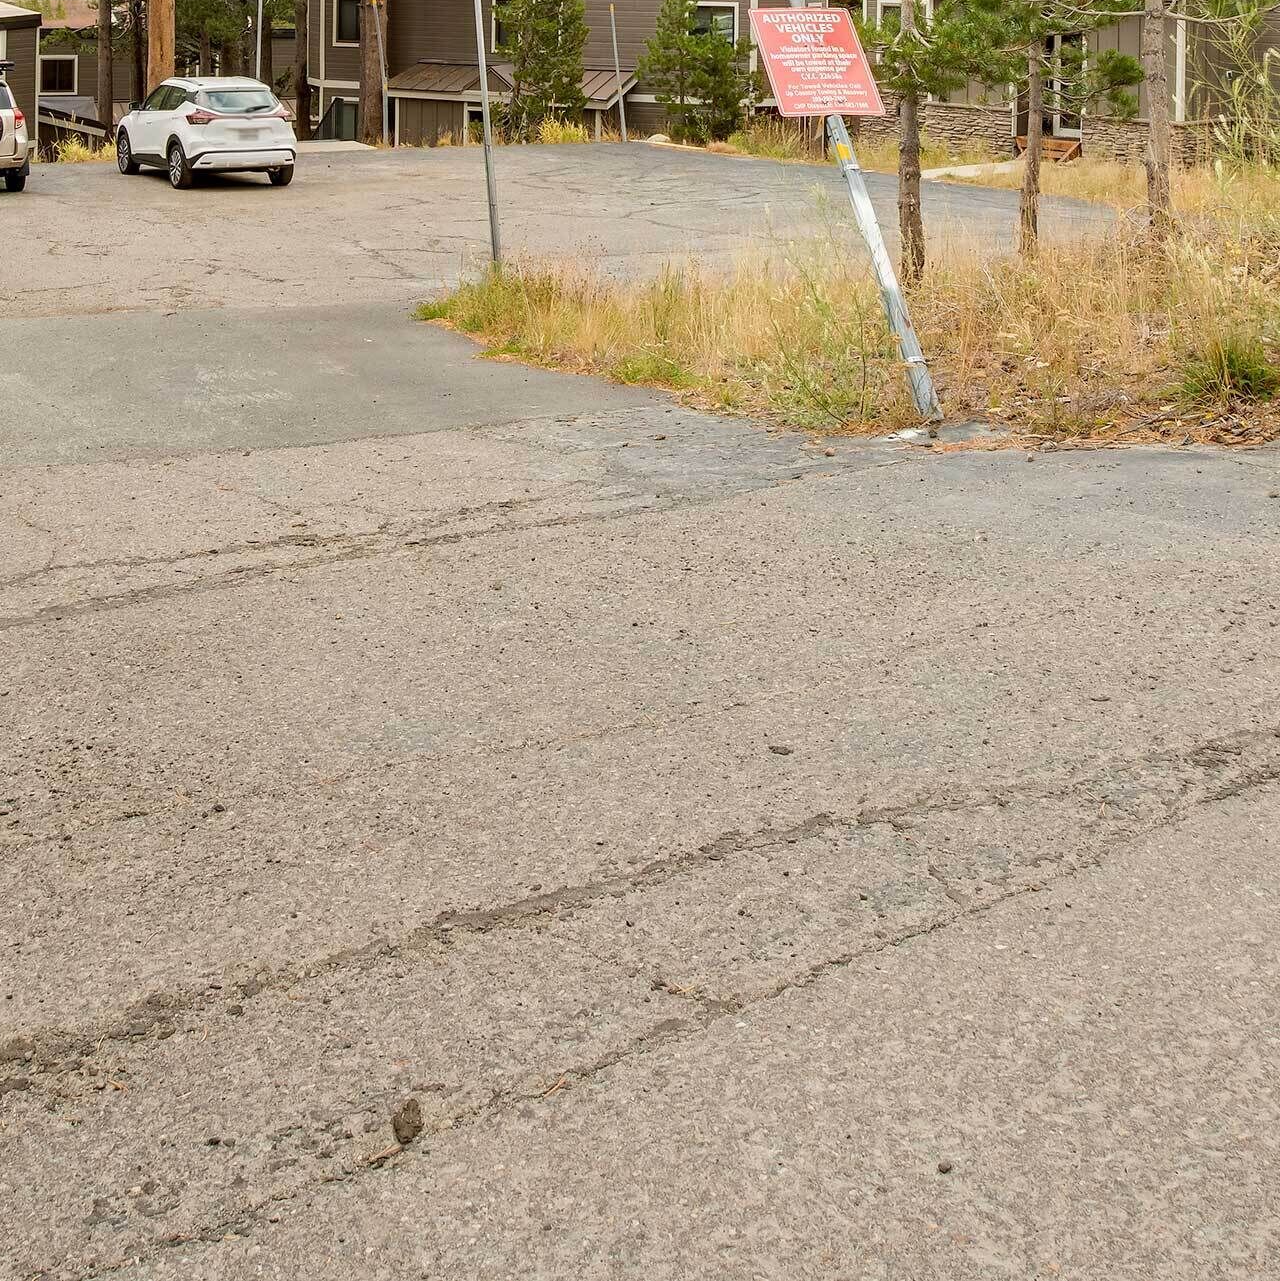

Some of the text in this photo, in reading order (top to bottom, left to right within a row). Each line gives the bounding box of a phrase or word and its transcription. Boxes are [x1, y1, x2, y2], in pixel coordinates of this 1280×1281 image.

[762, 13, 841, 24] AUTHORIZED
[776, 23, 834, 33] VEHICLES
[791, 33, 824, 44] ONLY
